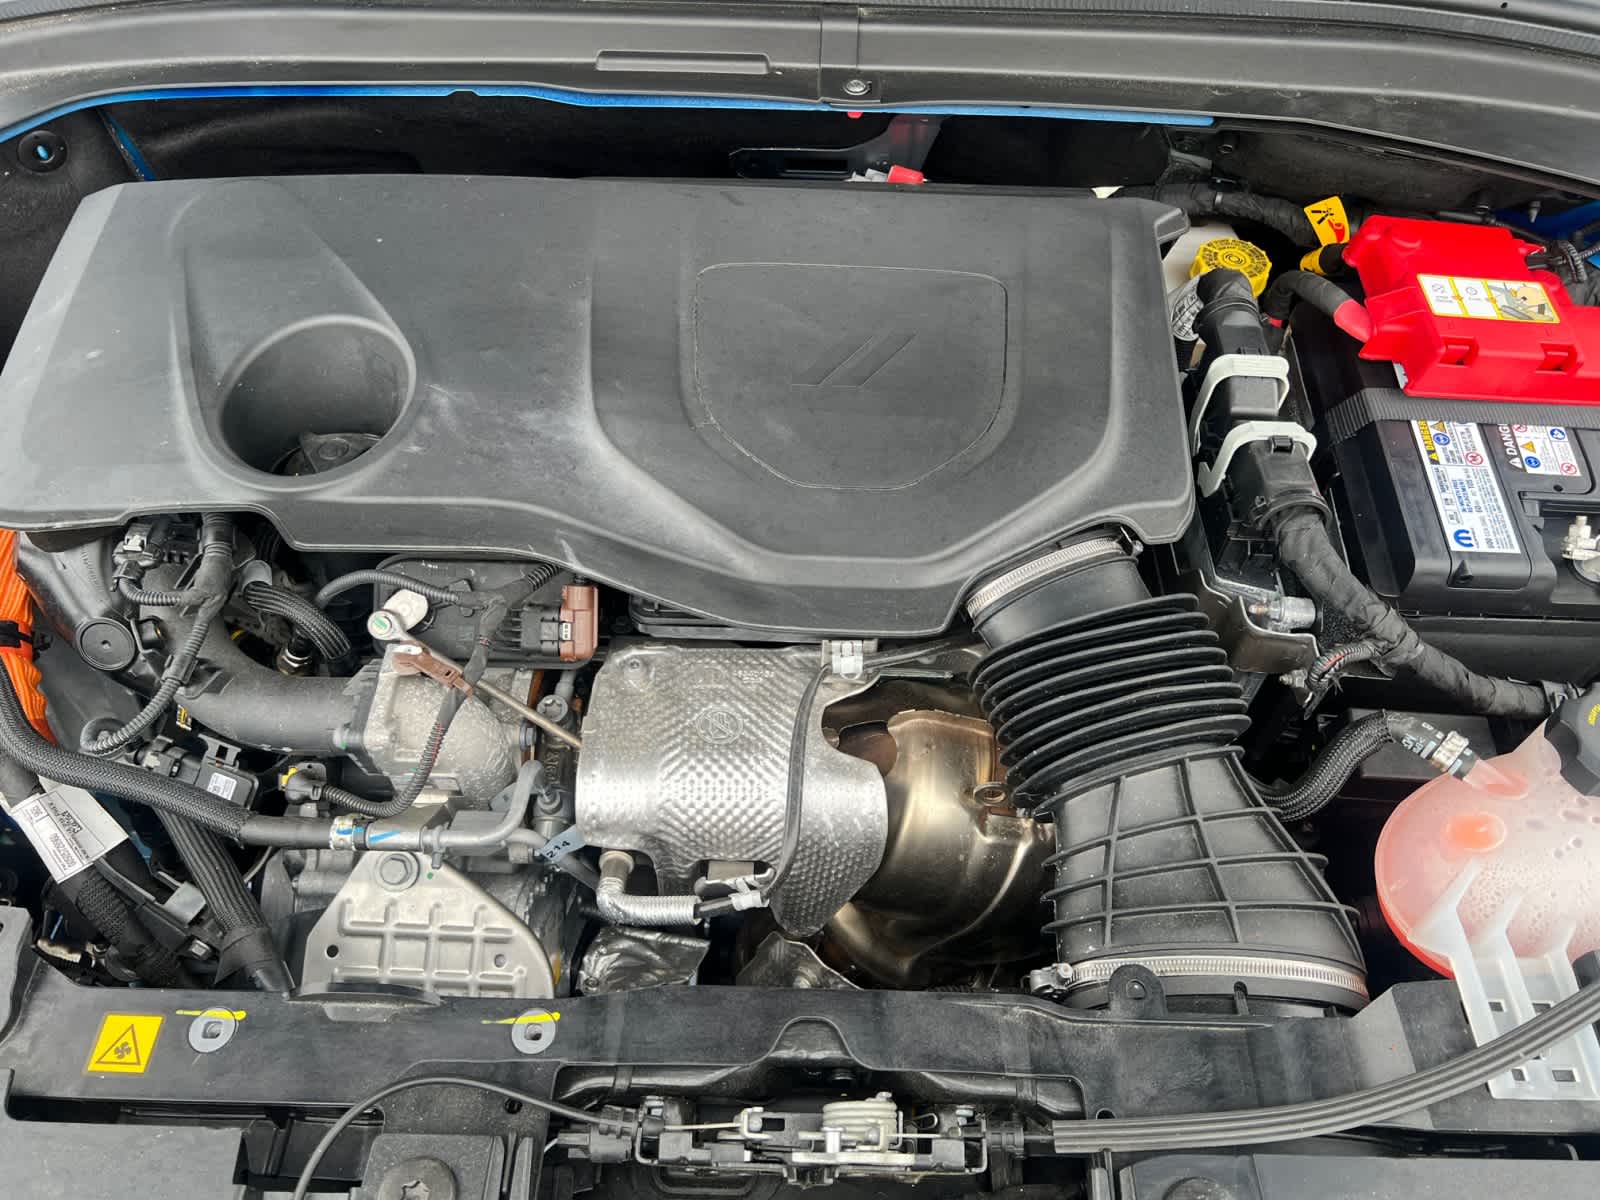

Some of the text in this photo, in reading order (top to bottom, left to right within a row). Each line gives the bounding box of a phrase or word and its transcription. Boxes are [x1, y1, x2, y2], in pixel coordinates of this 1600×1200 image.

[1418, 419, 1435, 451] DANGER
[1497, 424, 1518, 456] DANG
[546, 840, 570, 858] 214
